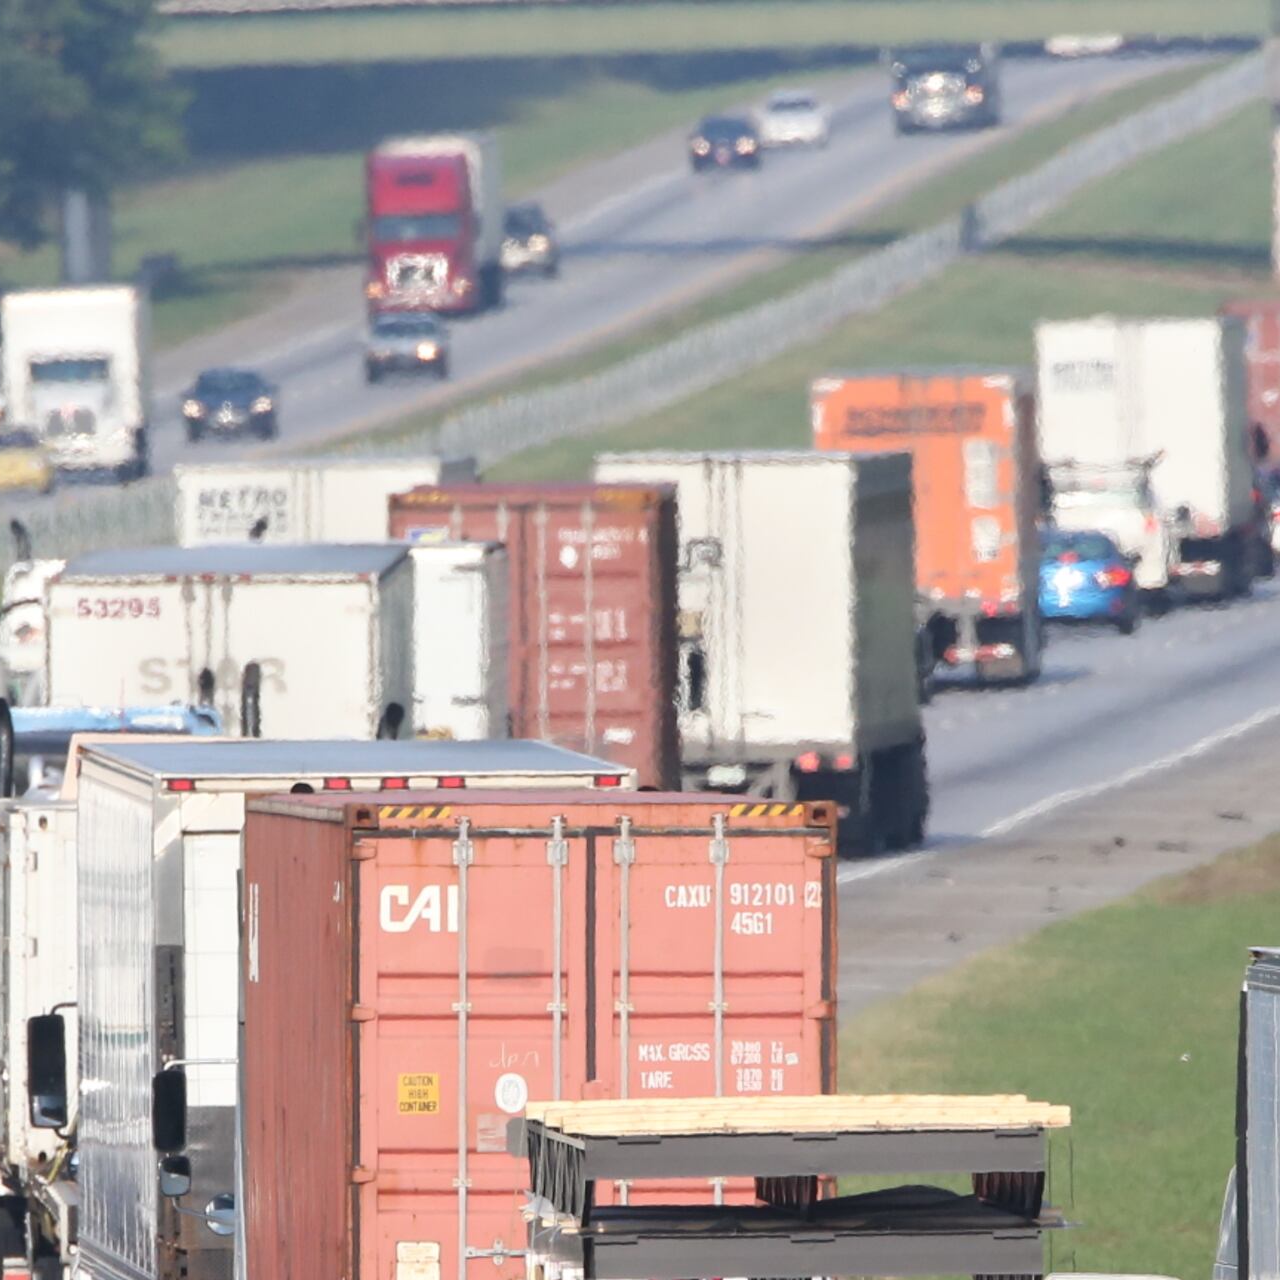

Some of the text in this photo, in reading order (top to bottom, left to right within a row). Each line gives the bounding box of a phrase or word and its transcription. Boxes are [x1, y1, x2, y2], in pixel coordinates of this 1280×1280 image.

[729, 882, 795, 907] 912101
[379, 884, 459, 933] CAI
[730, 911, 773, 935] 45G1
[669, 1042, 711, 1062] GROSS
[402, 1075, 434, 1087] CAUTION
[399, 1101, 438, 1113] CONTAINER
